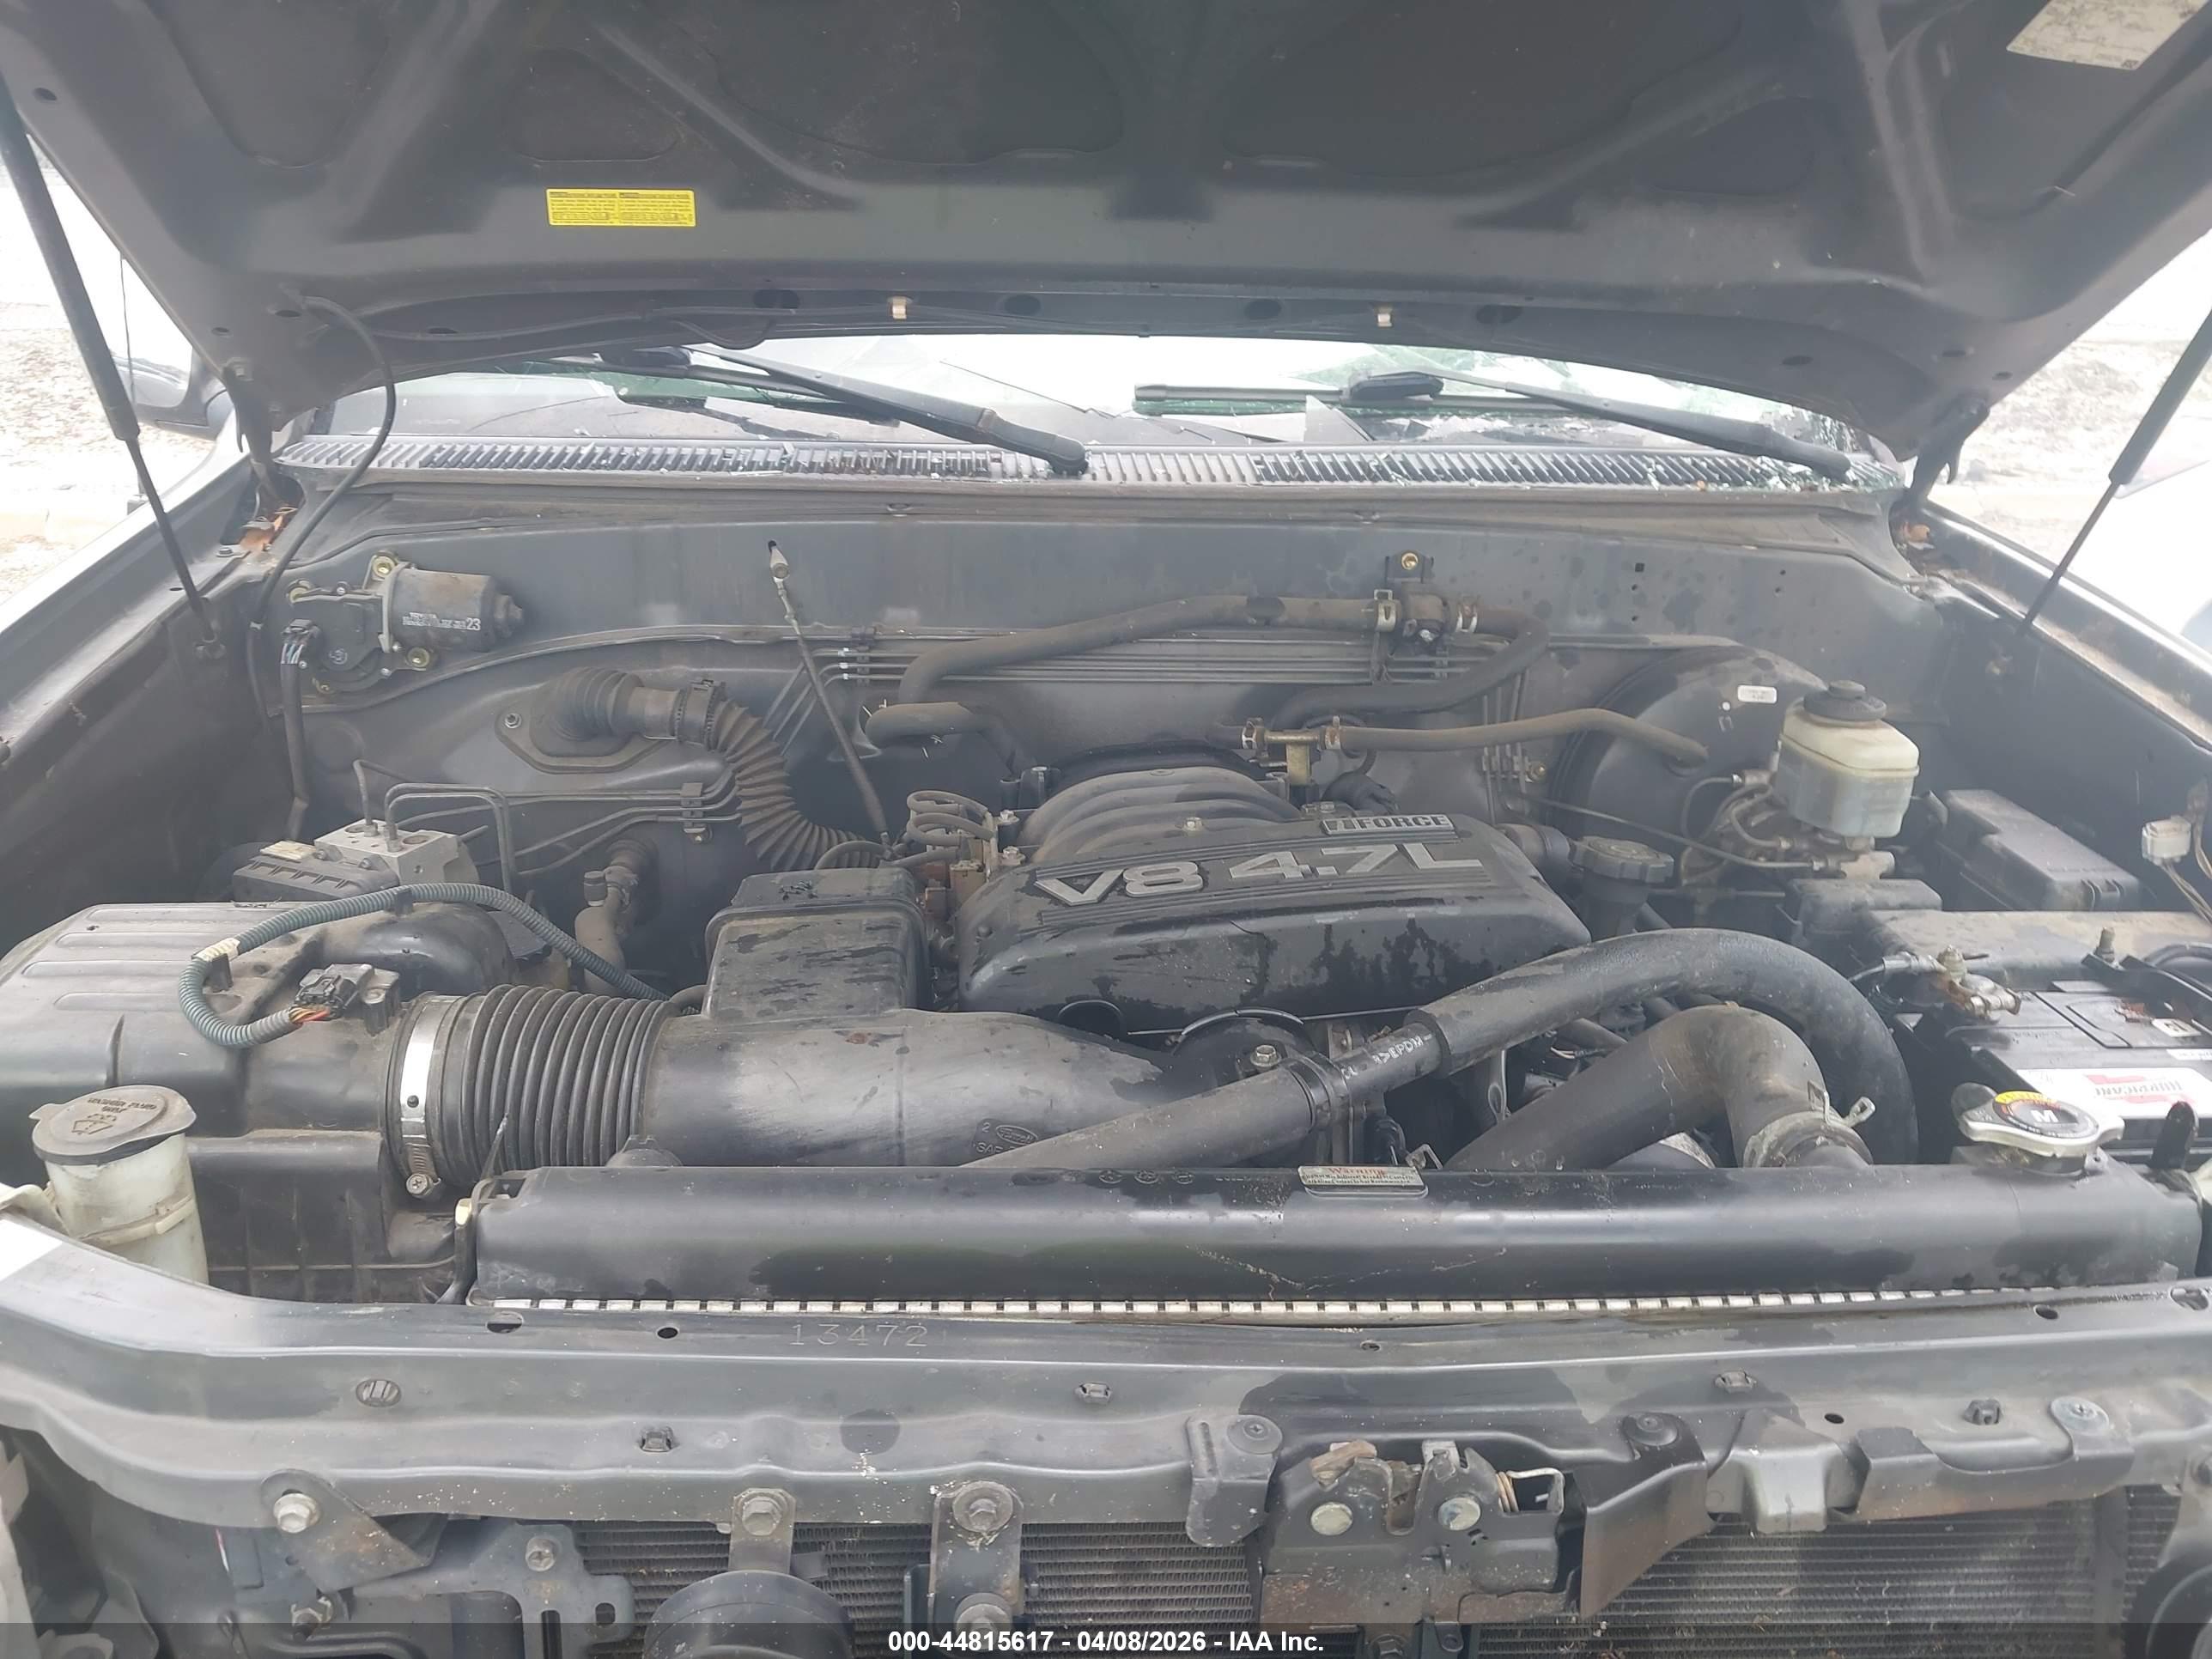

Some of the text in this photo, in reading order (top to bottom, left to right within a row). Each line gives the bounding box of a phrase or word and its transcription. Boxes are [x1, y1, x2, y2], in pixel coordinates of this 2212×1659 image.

[466, 617, 481, 631] 23
[1033, 842, 1484, 907] V8 4.7L
[981, 1121, 990, 1133] 2
[1328, 1168, 1386, 1177] Warning
[789, 1323, 928, 1347] 13472
